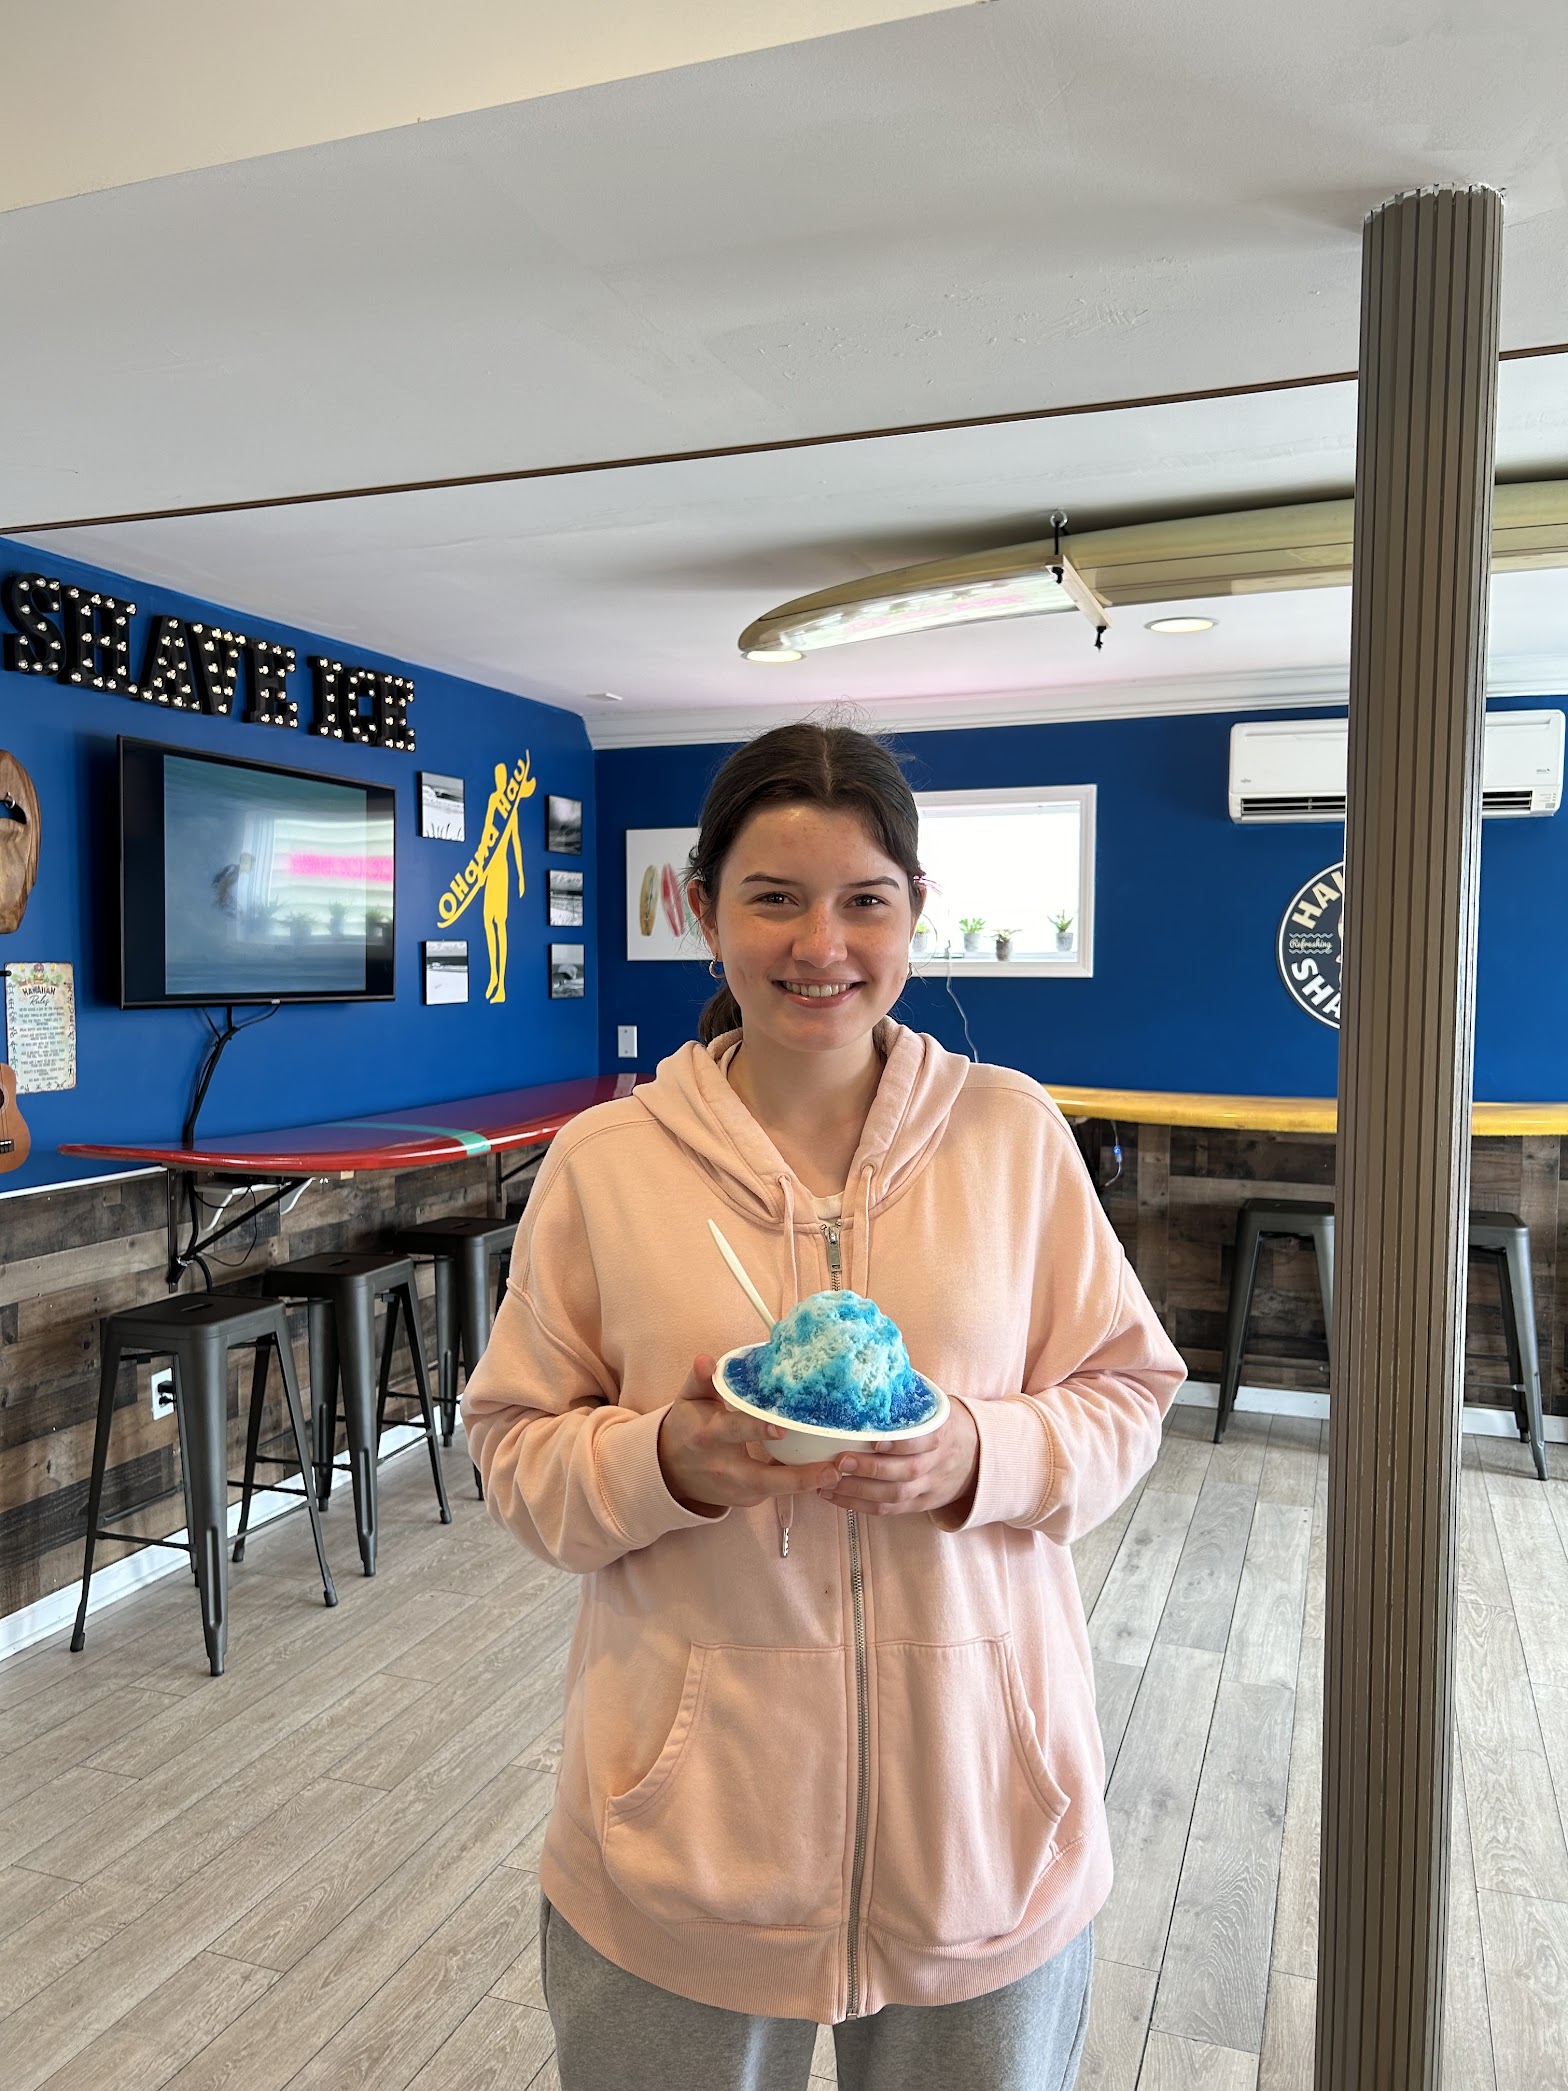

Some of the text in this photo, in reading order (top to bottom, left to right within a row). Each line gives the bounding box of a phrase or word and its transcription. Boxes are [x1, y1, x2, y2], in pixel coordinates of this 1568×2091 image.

[4, 572, 417, 752] SHAVE ICE
[1289, 937, 1333, 951] Refreshing
[22, 985, 56, 997] HAWAIIAN
[29, 994, 50, 1006] Rules
